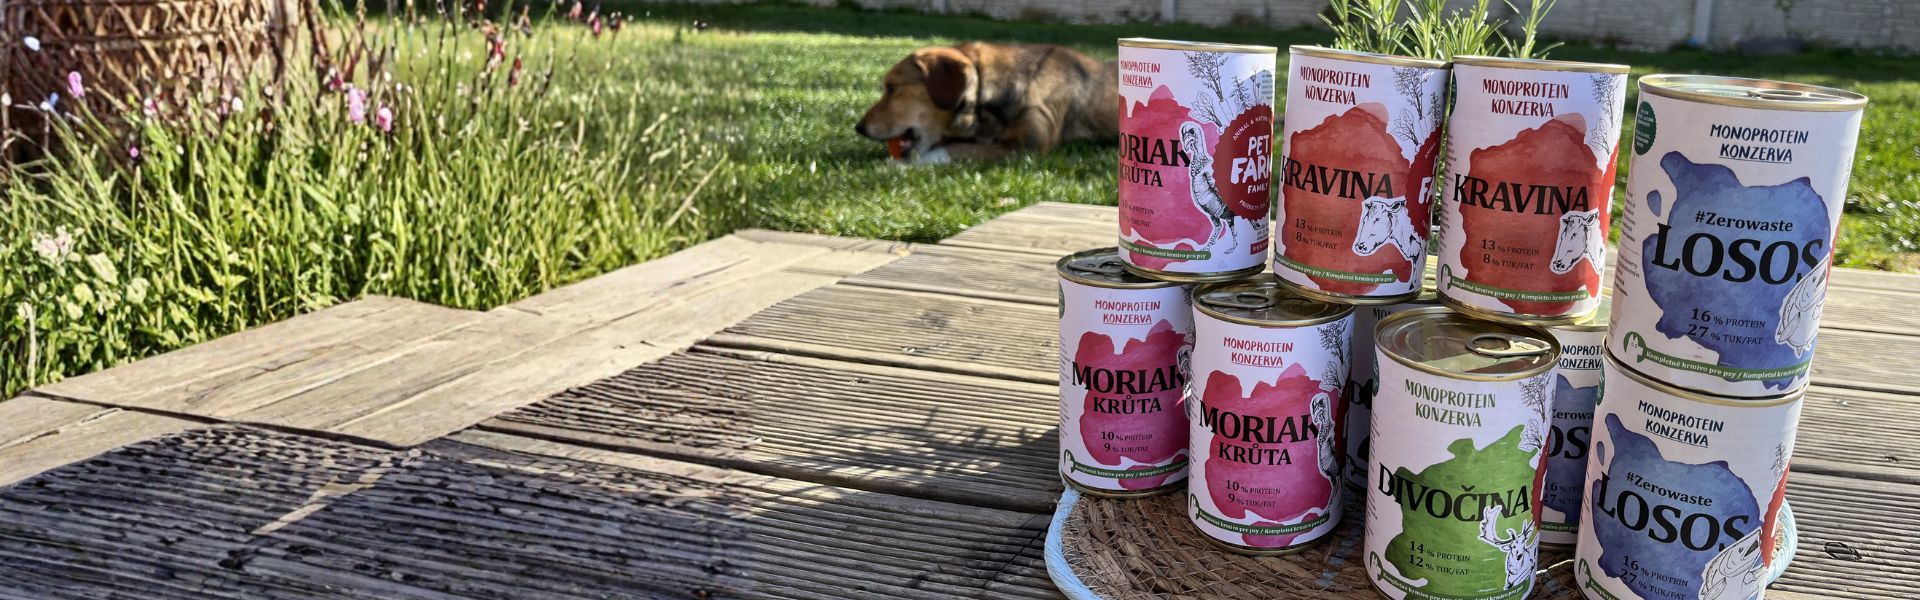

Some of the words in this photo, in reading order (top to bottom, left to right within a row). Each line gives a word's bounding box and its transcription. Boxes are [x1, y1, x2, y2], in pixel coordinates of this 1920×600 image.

[1299, 65, 1370, 88] MONOPROTEIN
[1304, 85, 1356, 106] KONZERVA
[1482, 78, 1569, 99] MONOPROTEIN
[1491, 98, 1555, 118] KONZERVA
[1709, 123, 1809, 144] MONOPROTEIN
[1247, 134, 1270, 157] PET
[1719, 144, 1793, 162] KONZERVA
[1247, 183, 1268, 194] FAMILY
[1280, 155, 1393, 200] KRAVINA
[1452, 173, 1590, 216] KRAVINA
[1295, 218, 1306, 229] 13
[1314, 226, 1343, 238] PROTEIN
[1694, 210, 1793, 232] #Zerowaste
[1296, 231, 1302, 242] 8
[1309, 238, 1338, 250] TUK/FAT
[1481, 239, 1496, 251] 13
[1507, 247, 1540, 256] PROTEIN
[1483, 253, 1491, 264] 8
[1501, 260, 1534, 270] TUK/FAT
[1650, 222, 1824, 286] LOSOS
[1094, 300, 1161, 311] MONOPROTEIN
[1505, 291, 1516, 299] psy
[1103, 313, 1152, 324] KONZERVA
[1690, 308, 1711, 321] 16
[1713, 315, 1724, 324] %
[1725, 318, 1766, 329] PROTEIN
[1223, 336, 1293, 353] MONOPROTEIN
[1687, 323, 1708, 338] 27
[1710, 331, 1721, 341] %
[1722, 333, 1763, 346] TUK/FAT
[1231, 351, 1283, 367] KONZERVA
[1645, 350, 1680, 366] Kompletné
[1680, 360, 1707, 374] krmivo
[1708, 367, 1721, 376] pre
[1722, 369, 1736, 378] psy
[1743, 369, 1776, 380] Kompletní
[1071, 361, 1185, 395] MORIAK
[1404, 378, 1496, 408] MONOPROTEIN
[1093, 395, 1162, 415] KRŮTA
[1415, 402, 1482, 427] KONZERVA
[1638, 400, 1724, 432] MONOPROTEIN
[1198, 399, 1319, 444] MORIAK
[1101, 430, 1115, 441] 10
[1124, 433, 1153, 441] PROTEIN
[1646, 420, 1709, 447] KONZERVA
[1104, 443, 1111, 452] 9
[1120, 445, 1148, 453] TUK/FAT
[1218, 443, 1292, 466] KRŮTA
[1225, 480, 1239, 491] 10
[1240, 485, 1248, 493] %
[1249, 486, 1281, 495] PROTEIN
[1378, 462, 1530, 522] DIVOČINA
[1626, 471, 1713, 507] #Zerowaste
[1228, 493, 1235, 503] 9
[1236, 498, 1244, 506] %
[1244, 499, 1277, 508] TUK/FAT
[1596, 471, 1750, 553] LOSOS
[1409, 540, 1425, 554] 14
[1426, 550, 1435, 558] %
[1436, 552, 1471, 562] PROTEIN
[1409, 554, 1424, 567] 12
[1425, 563, 1434, 571] %
[1435, 565, 1470, 576] TUK/FAT
[1623, 555, 1639, 571] 16
[1640, 567, 1649, 577] %
[1651, 572, 1689, 587] PROTEIN
[1621, 568, 1637, 583] 27
[1638, 580, 1647, 590] %
[1648, 584, 1687, 600] TUK/FAT
